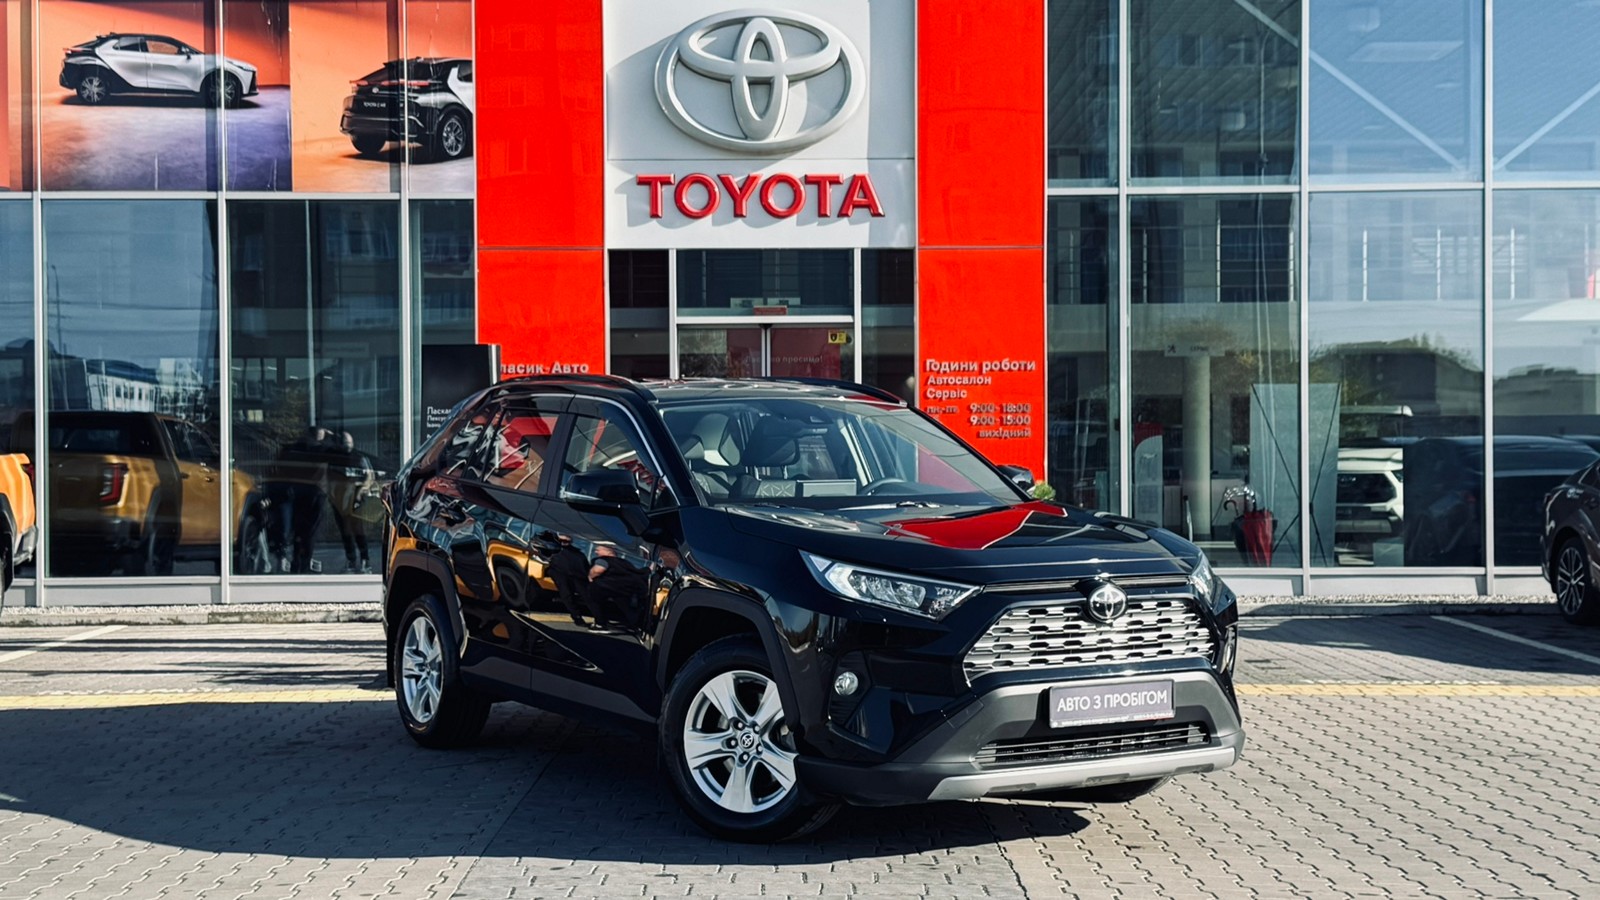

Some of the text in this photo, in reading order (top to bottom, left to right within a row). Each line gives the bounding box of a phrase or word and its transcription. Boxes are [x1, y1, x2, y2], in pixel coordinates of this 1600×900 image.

[635, 172, 886, 219] TOYOTA
[500, 361, 590, 374] ласик-Авто
[925, 358, 1036, 374] Години роботи
[927, 375, 992, 385] Автосалон
[926, 387, 968, 400] Сервіс
[979, 427, 1032, 439] вихідний
[1057, 689, 1168, 712] АВТО З ПРОБІГОМ
